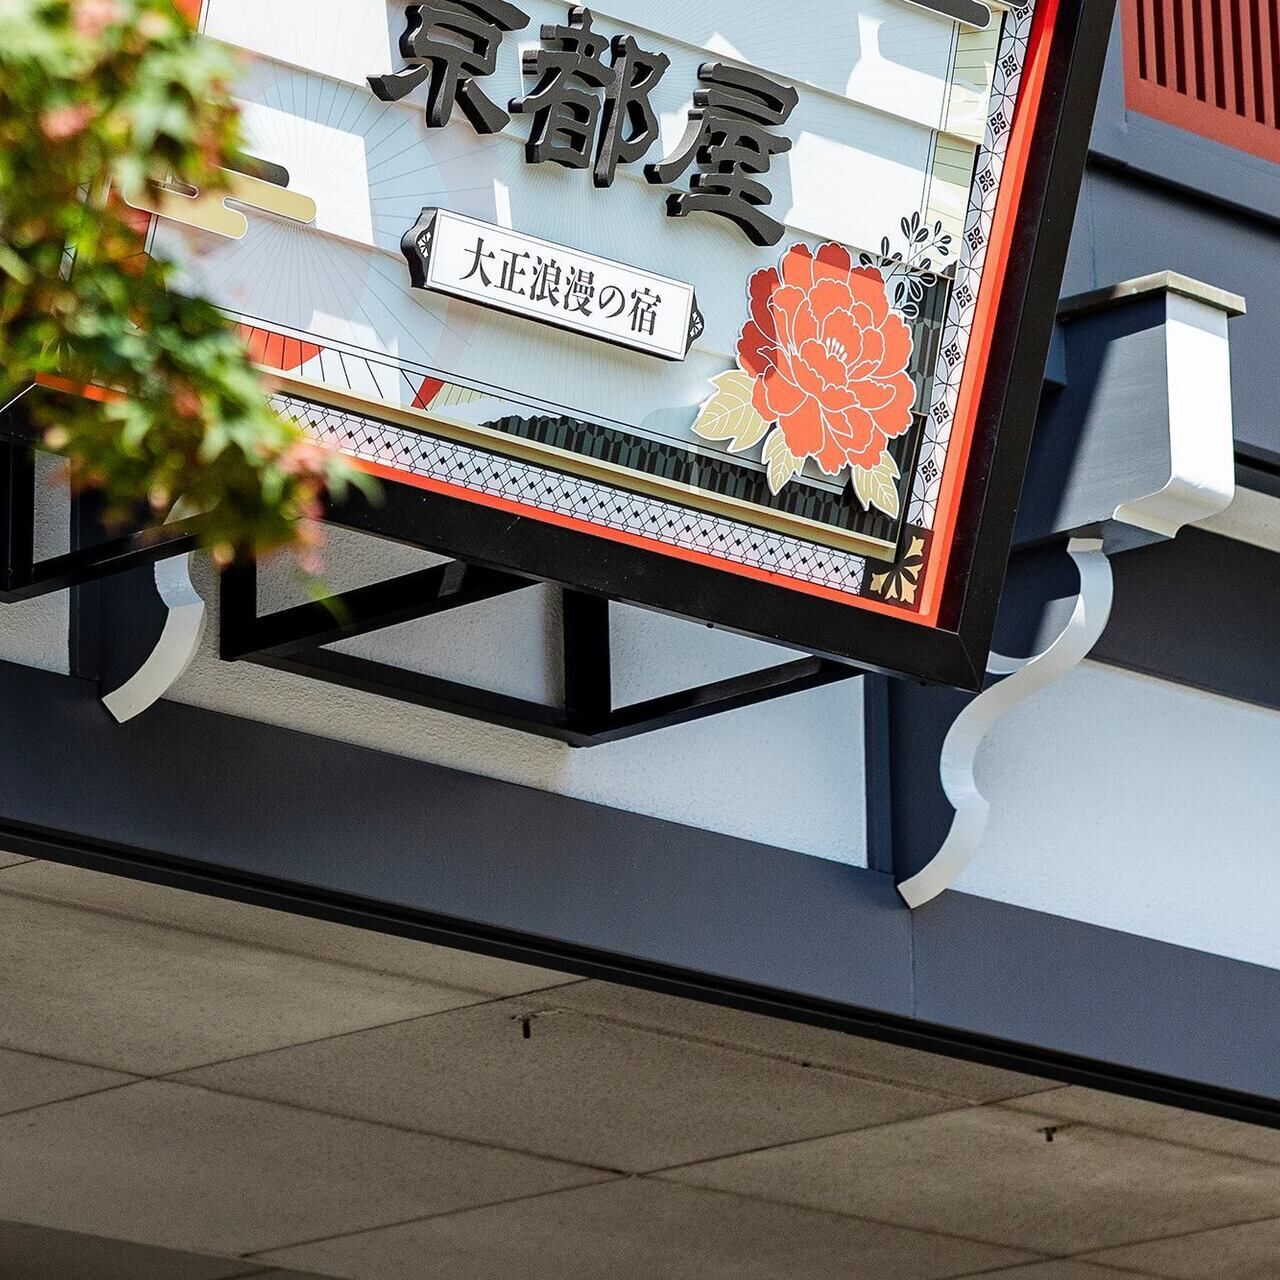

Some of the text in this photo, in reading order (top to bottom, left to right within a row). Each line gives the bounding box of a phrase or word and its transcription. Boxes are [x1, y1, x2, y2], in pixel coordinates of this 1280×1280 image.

[460, 236, 662, 336] 大正浪漫の宿
